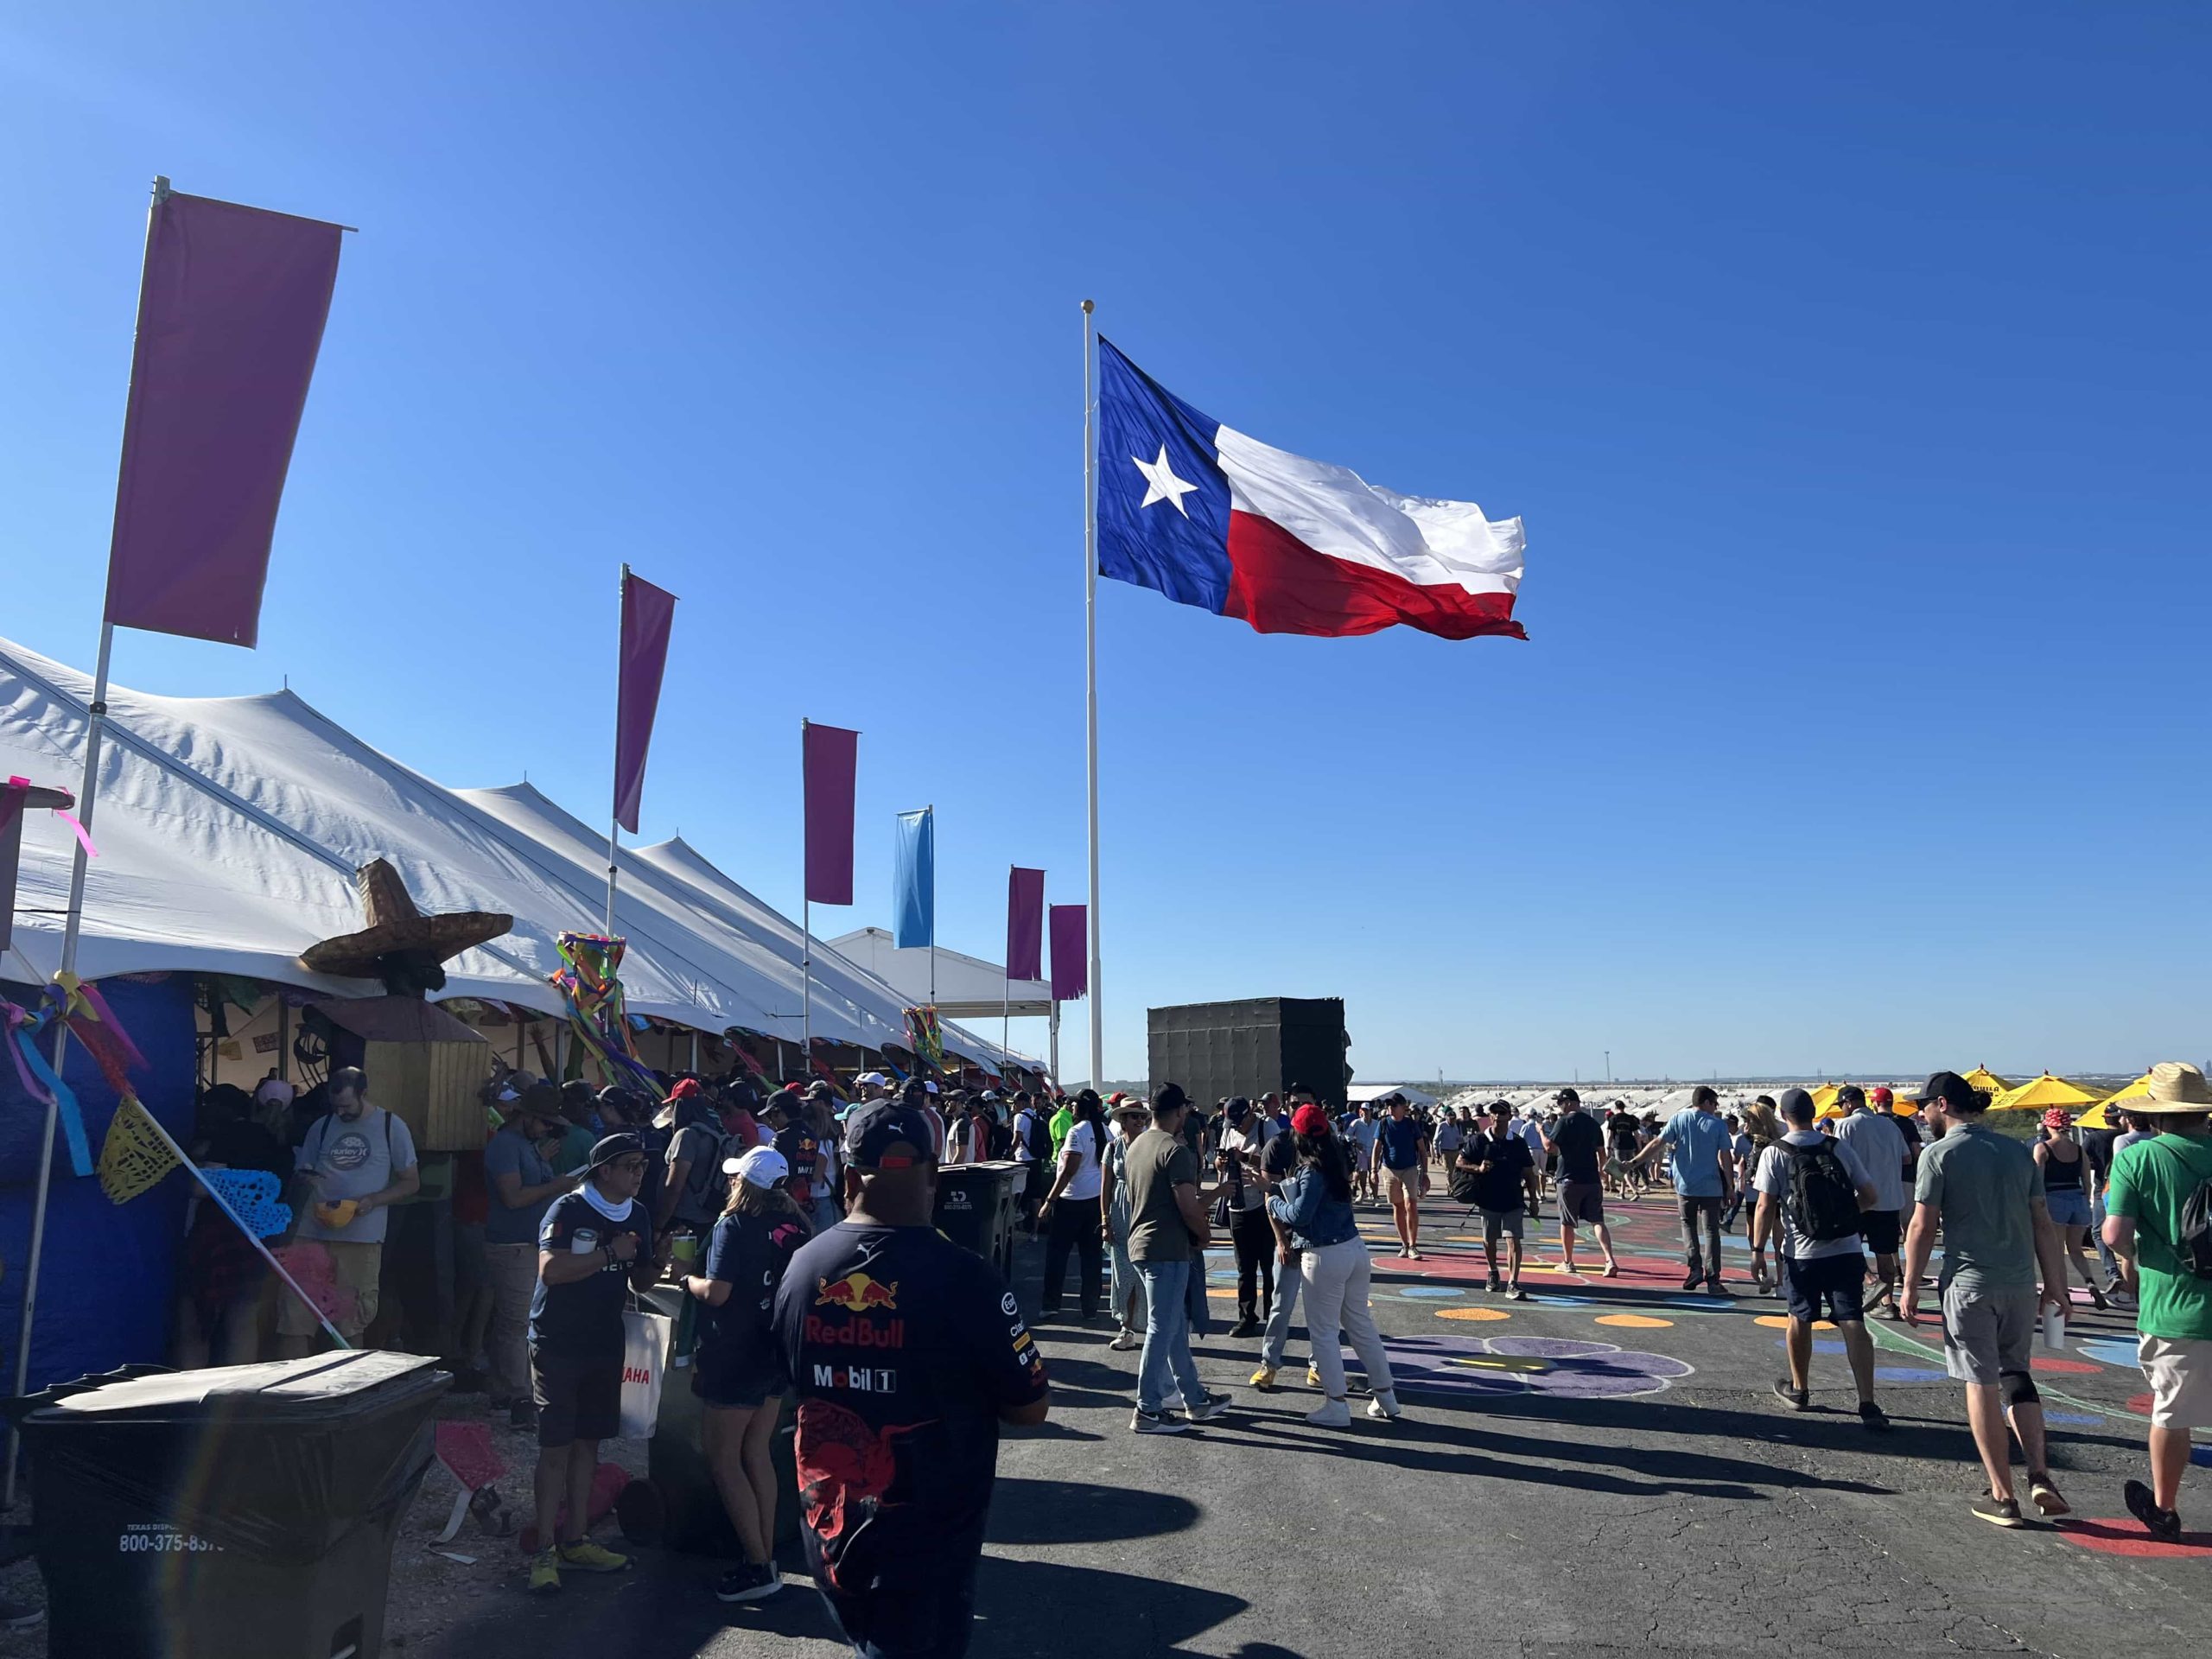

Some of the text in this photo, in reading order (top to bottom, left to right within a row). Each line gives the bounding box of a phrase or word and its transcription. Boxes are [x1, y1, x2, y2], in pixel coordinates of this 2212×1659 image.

[1010, 1319, 1024, 1337] Cla
[622, 1367, 650, 1384] AHA
[813, 1364, 871, 1391] Mobil
